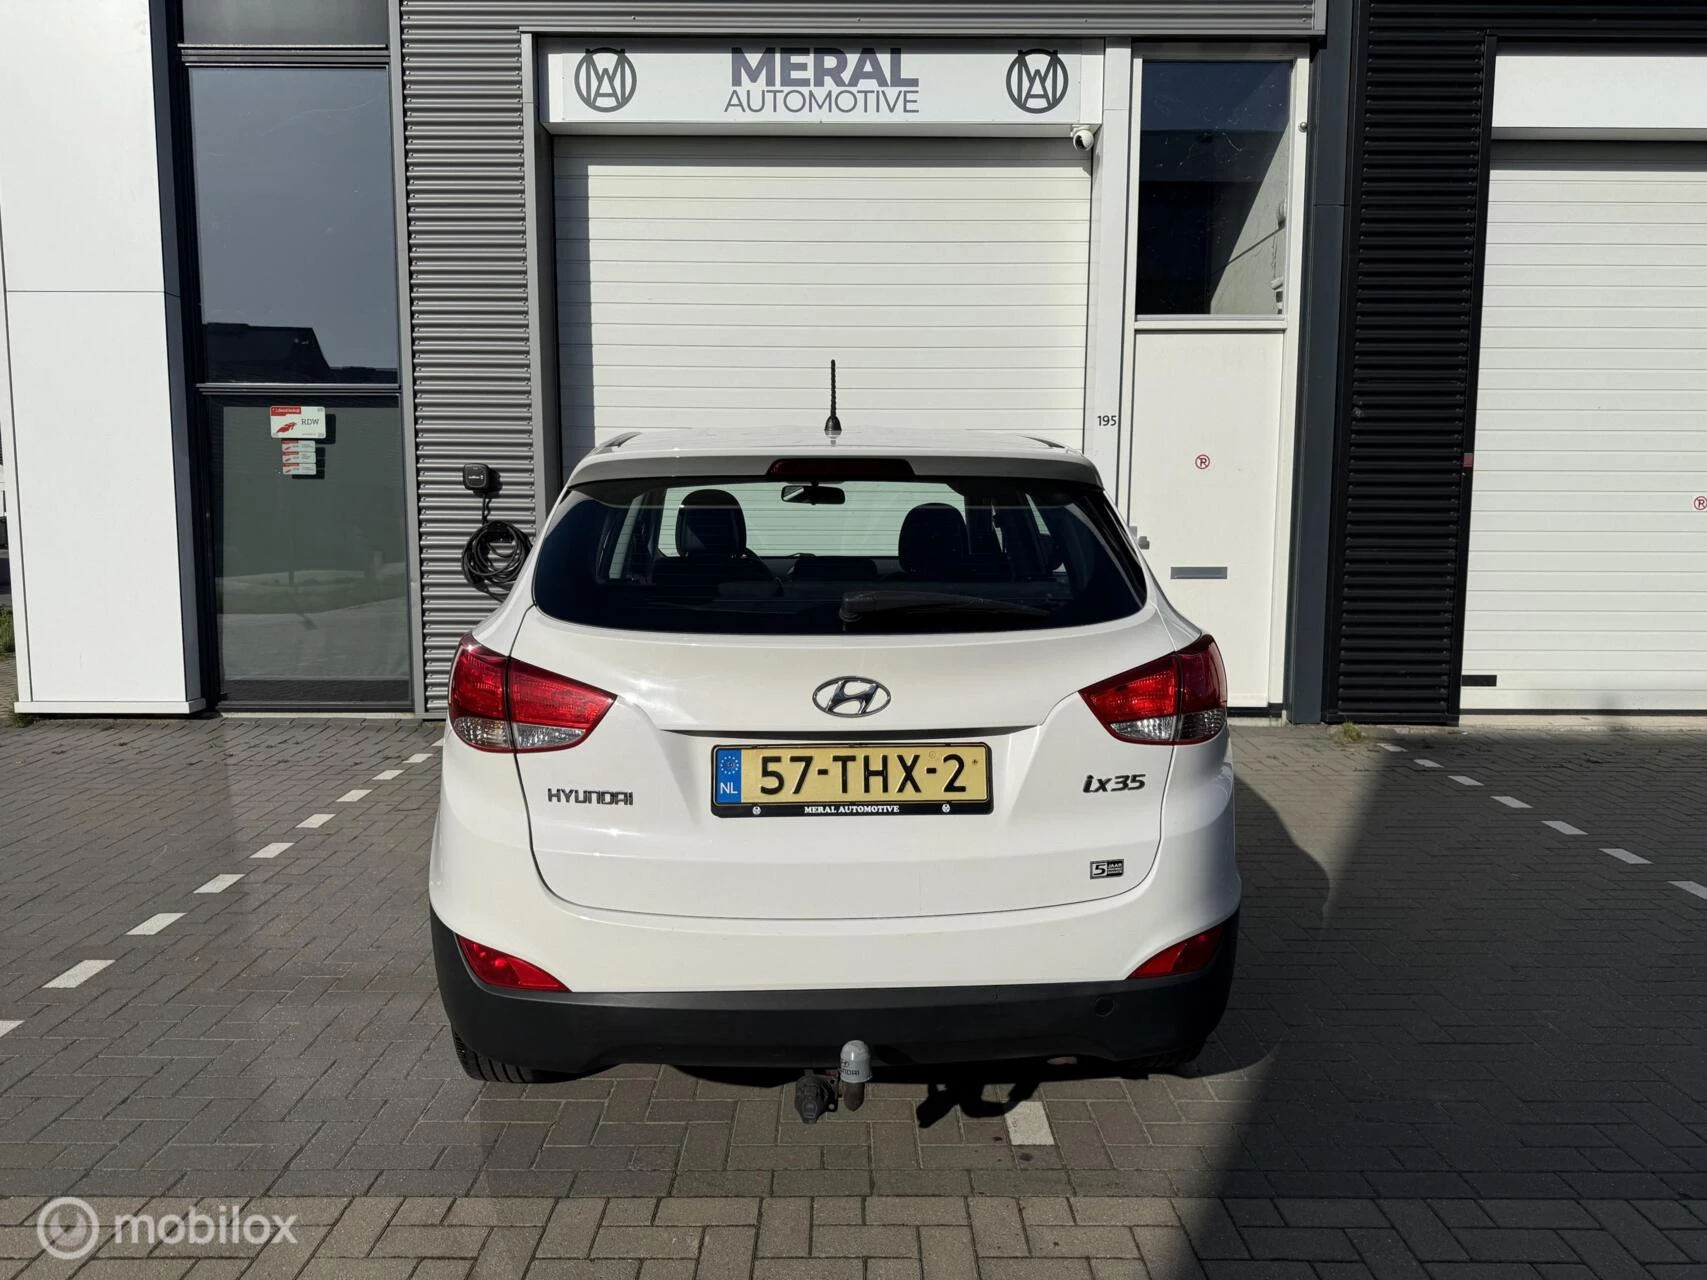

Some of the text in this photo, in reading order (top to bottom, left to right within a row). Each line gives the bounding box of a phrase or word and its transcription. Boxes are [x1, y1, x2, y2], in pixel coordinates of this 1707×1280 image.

[731, 47, 919, 87] MERAL
[723, 89, 920, 113] AUTOMOTIVE
[1097, 415, 1117, 426] 195
[759, 754, 967, 796] 57-THX-2
[1083, 774, 1146, 793] ix35
[547, 788, 633, 805] HYUNDAI
[720, 782, 738, 794] NL
[804, 804, 900, 814] MERAL AUTOMOTIVE
[1093, 864, 1106, 876] 5
